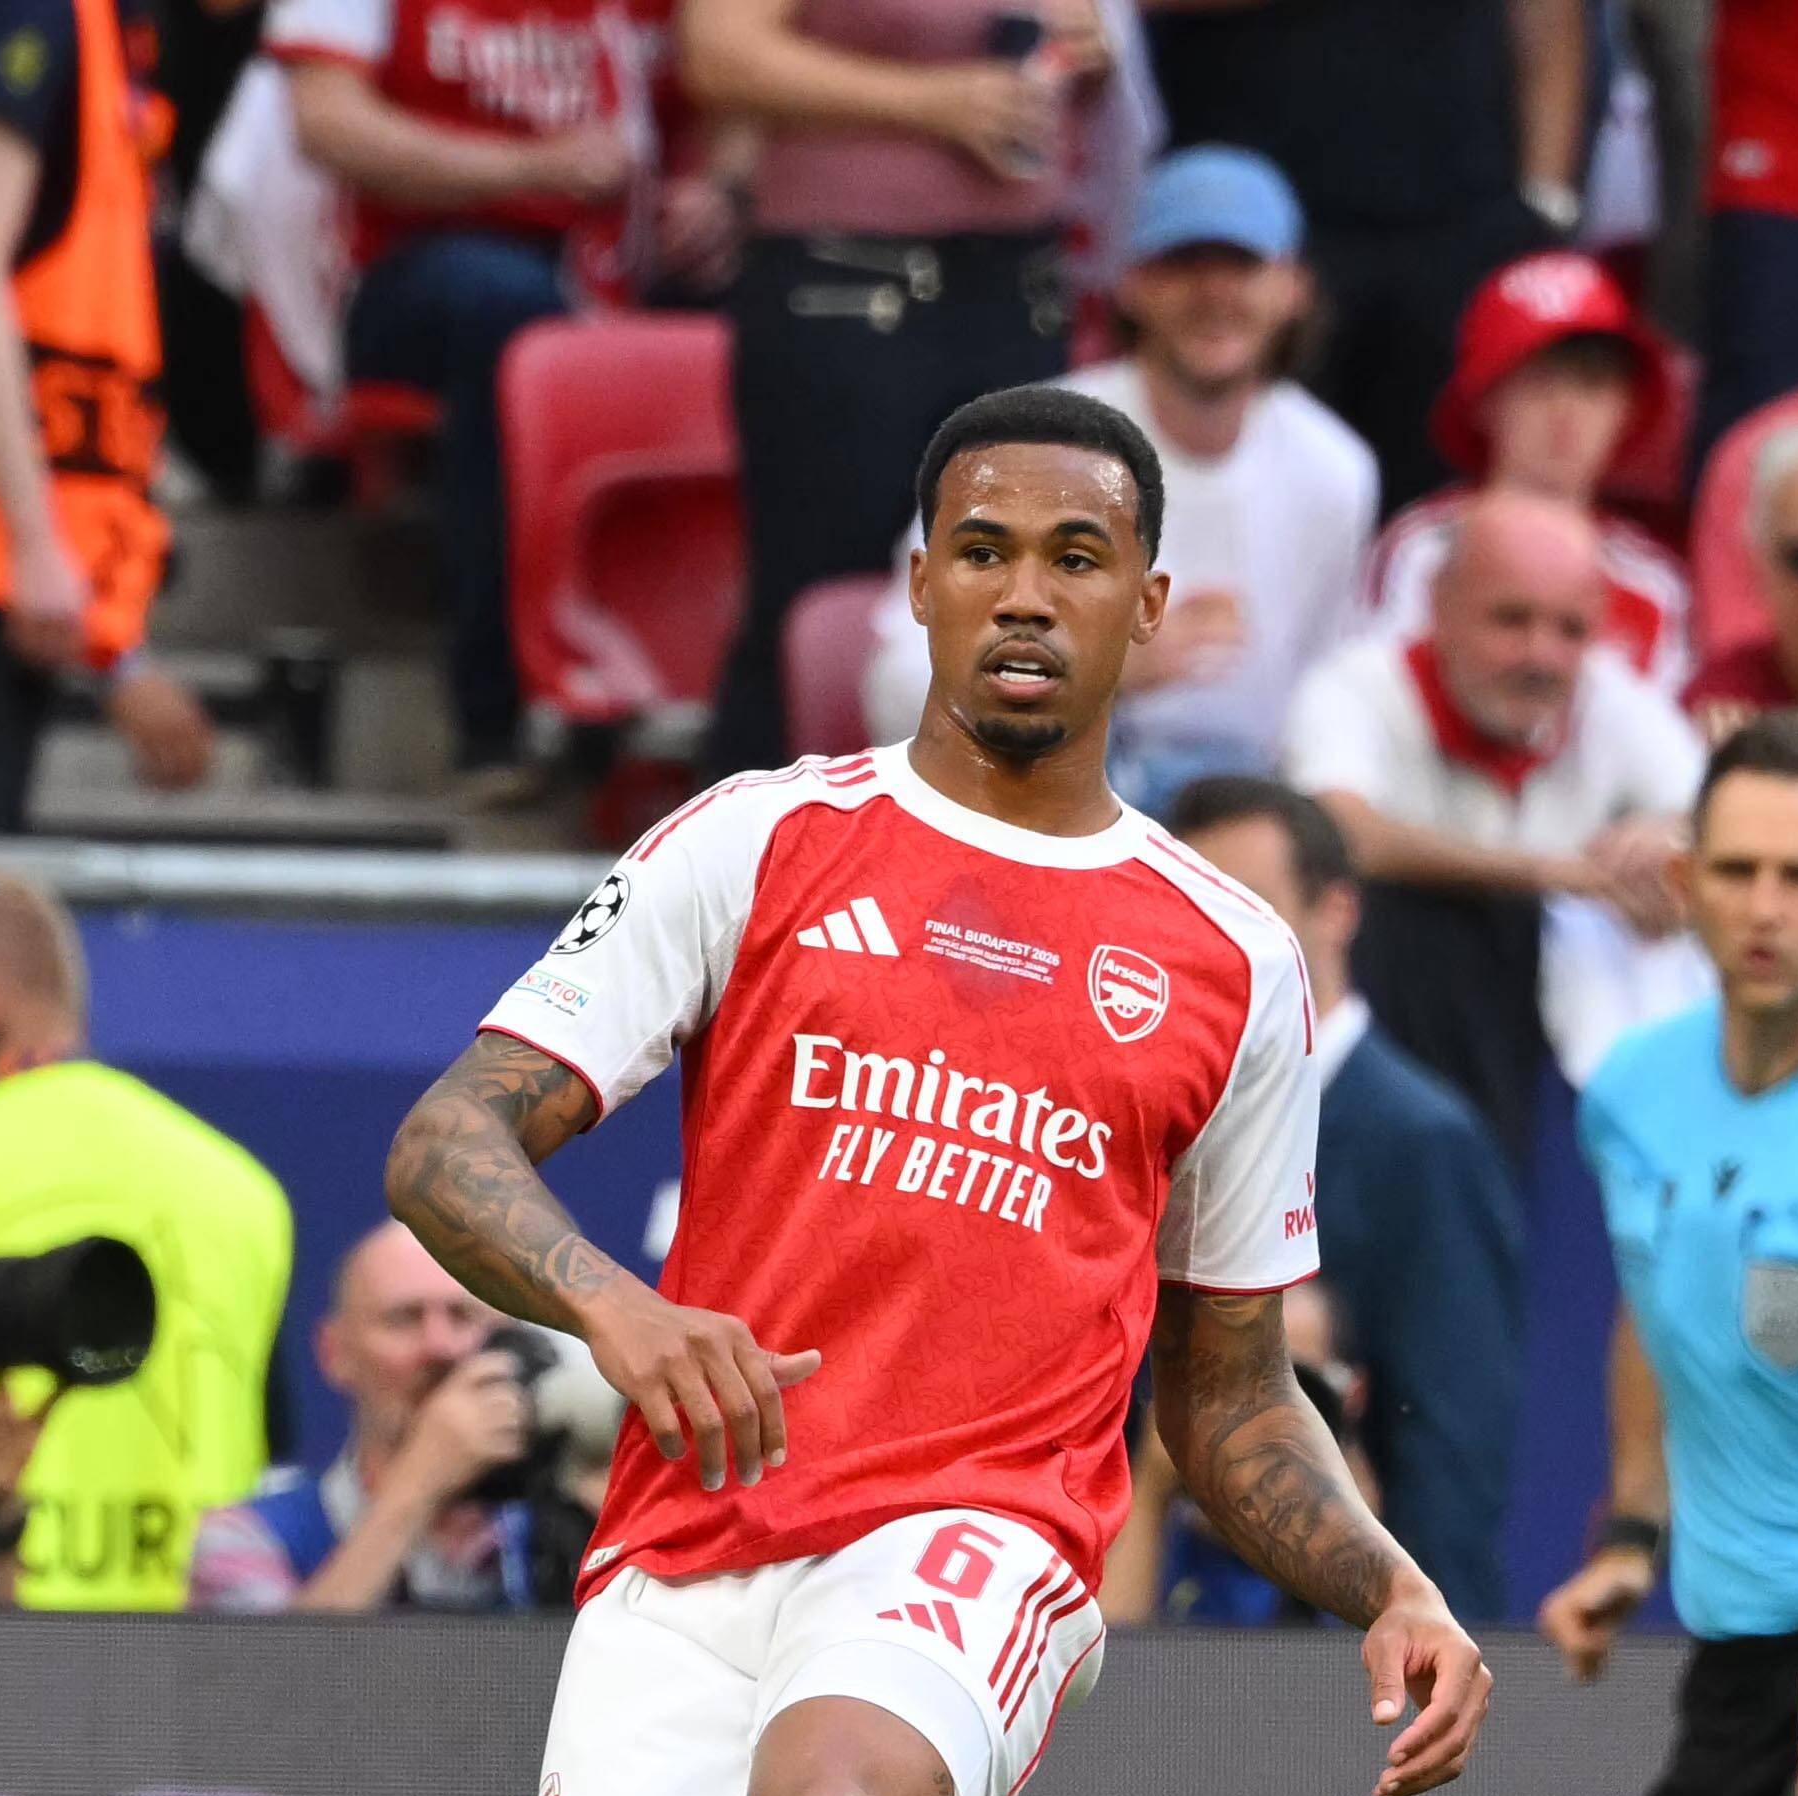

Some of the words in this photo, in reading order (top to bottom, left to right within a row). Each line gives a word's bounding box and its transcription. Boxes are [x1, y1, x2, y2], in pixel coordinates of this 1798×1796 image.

[924, 919, 963, 939] FINAL
[964, 929, 1031, 957] BUDAPEST
[1030, 947, 1061, 967] 2026
[1102, 958, 1158, 994] Arsenal
[790, 1032, 1113, 1180] Emirates
[817, 1123, 896, 1186] FLY
[895, 1134, 1053, 1233] BETTER
[1284, 1202, 1316, 1241] RW
[911, 1518, 1007, 1601] 6
